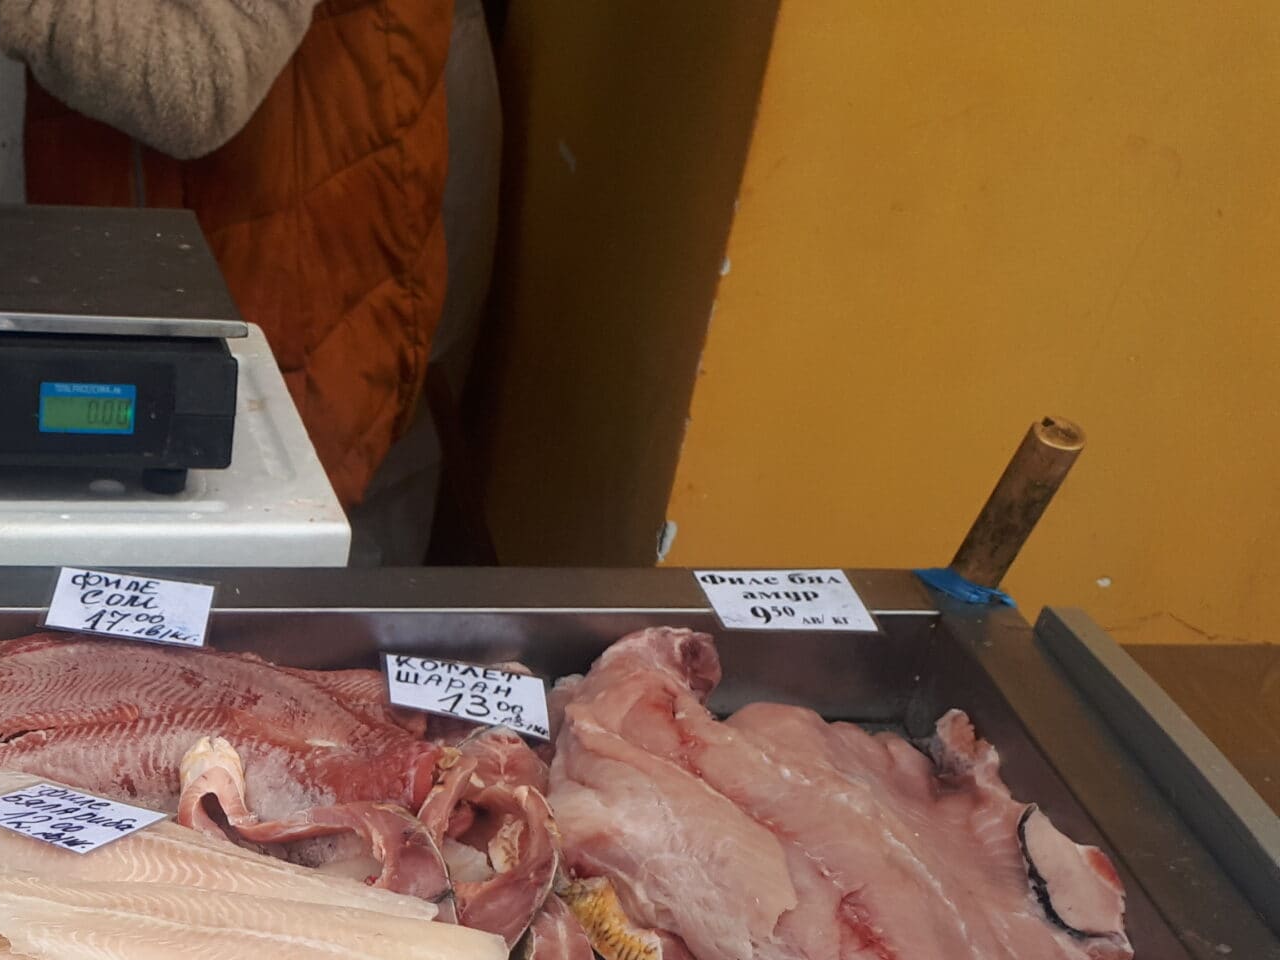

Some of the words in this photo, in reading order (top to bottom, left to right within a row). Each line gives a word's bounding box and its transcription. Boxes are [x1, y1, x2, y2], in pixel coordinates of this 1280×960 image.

[700, 573, 779, 585] Филе
[788, 572, 841, 585] бял
[743, 590, 819, 602] амур
[395, 655, 521, 682] КОТЛЕТ
[395, 670, 513, 697] ШАРАН
